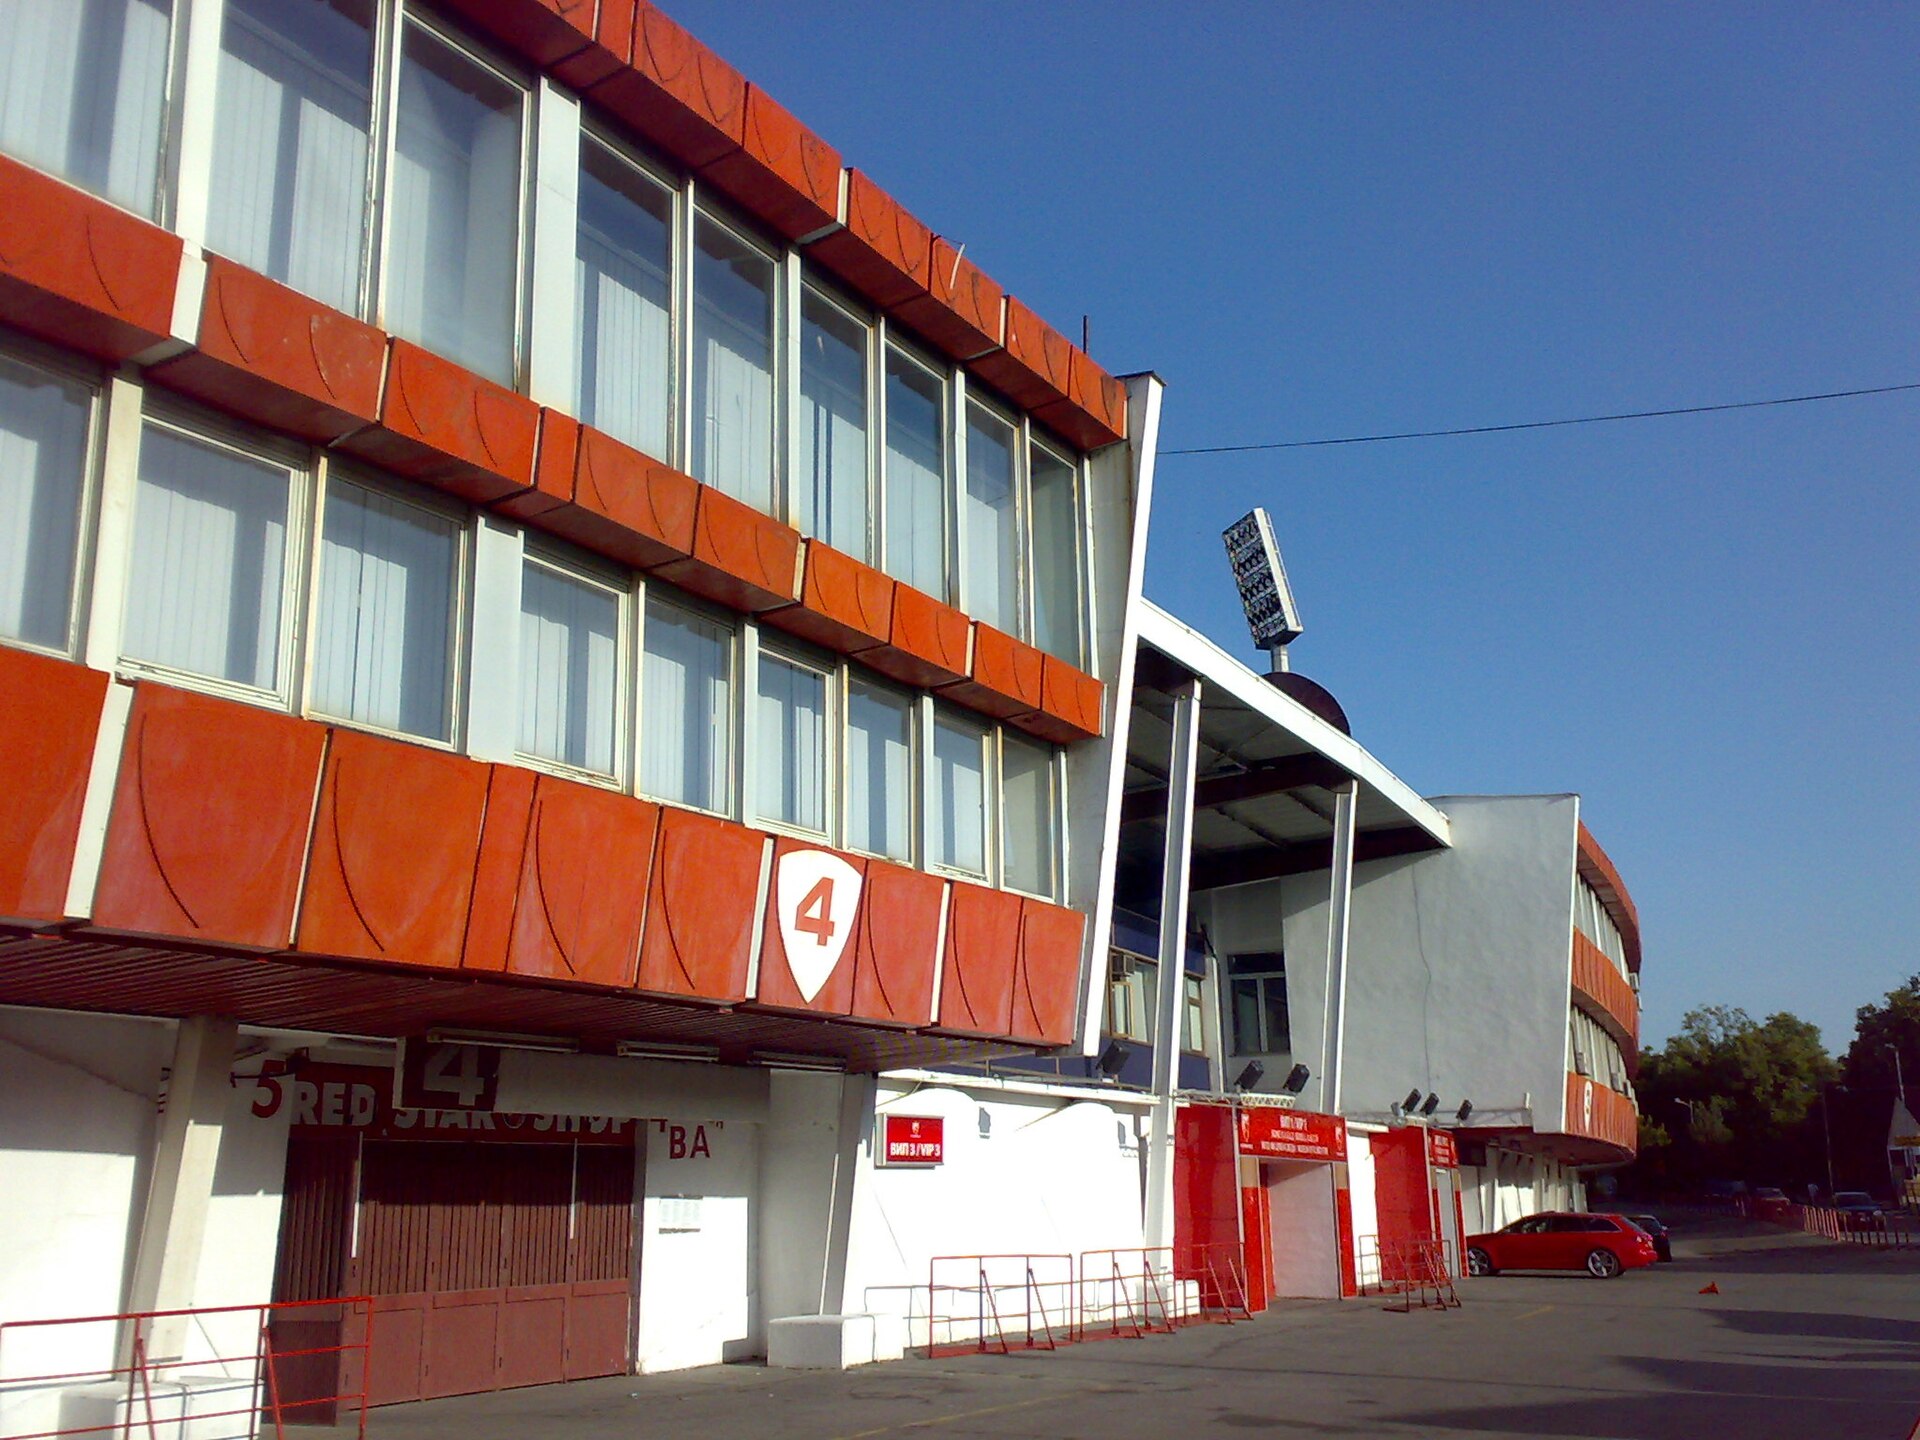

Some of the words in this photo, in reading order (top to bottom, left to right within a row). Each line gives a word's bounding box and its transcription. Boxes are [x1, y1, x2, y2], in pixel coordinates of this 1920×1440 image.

[794, 876, 835, 947] 4
[251, 1059, 283, 1119] 5
[296, 1081, 377, 1127] RED
[423, 1046, 485, 1107] 4
